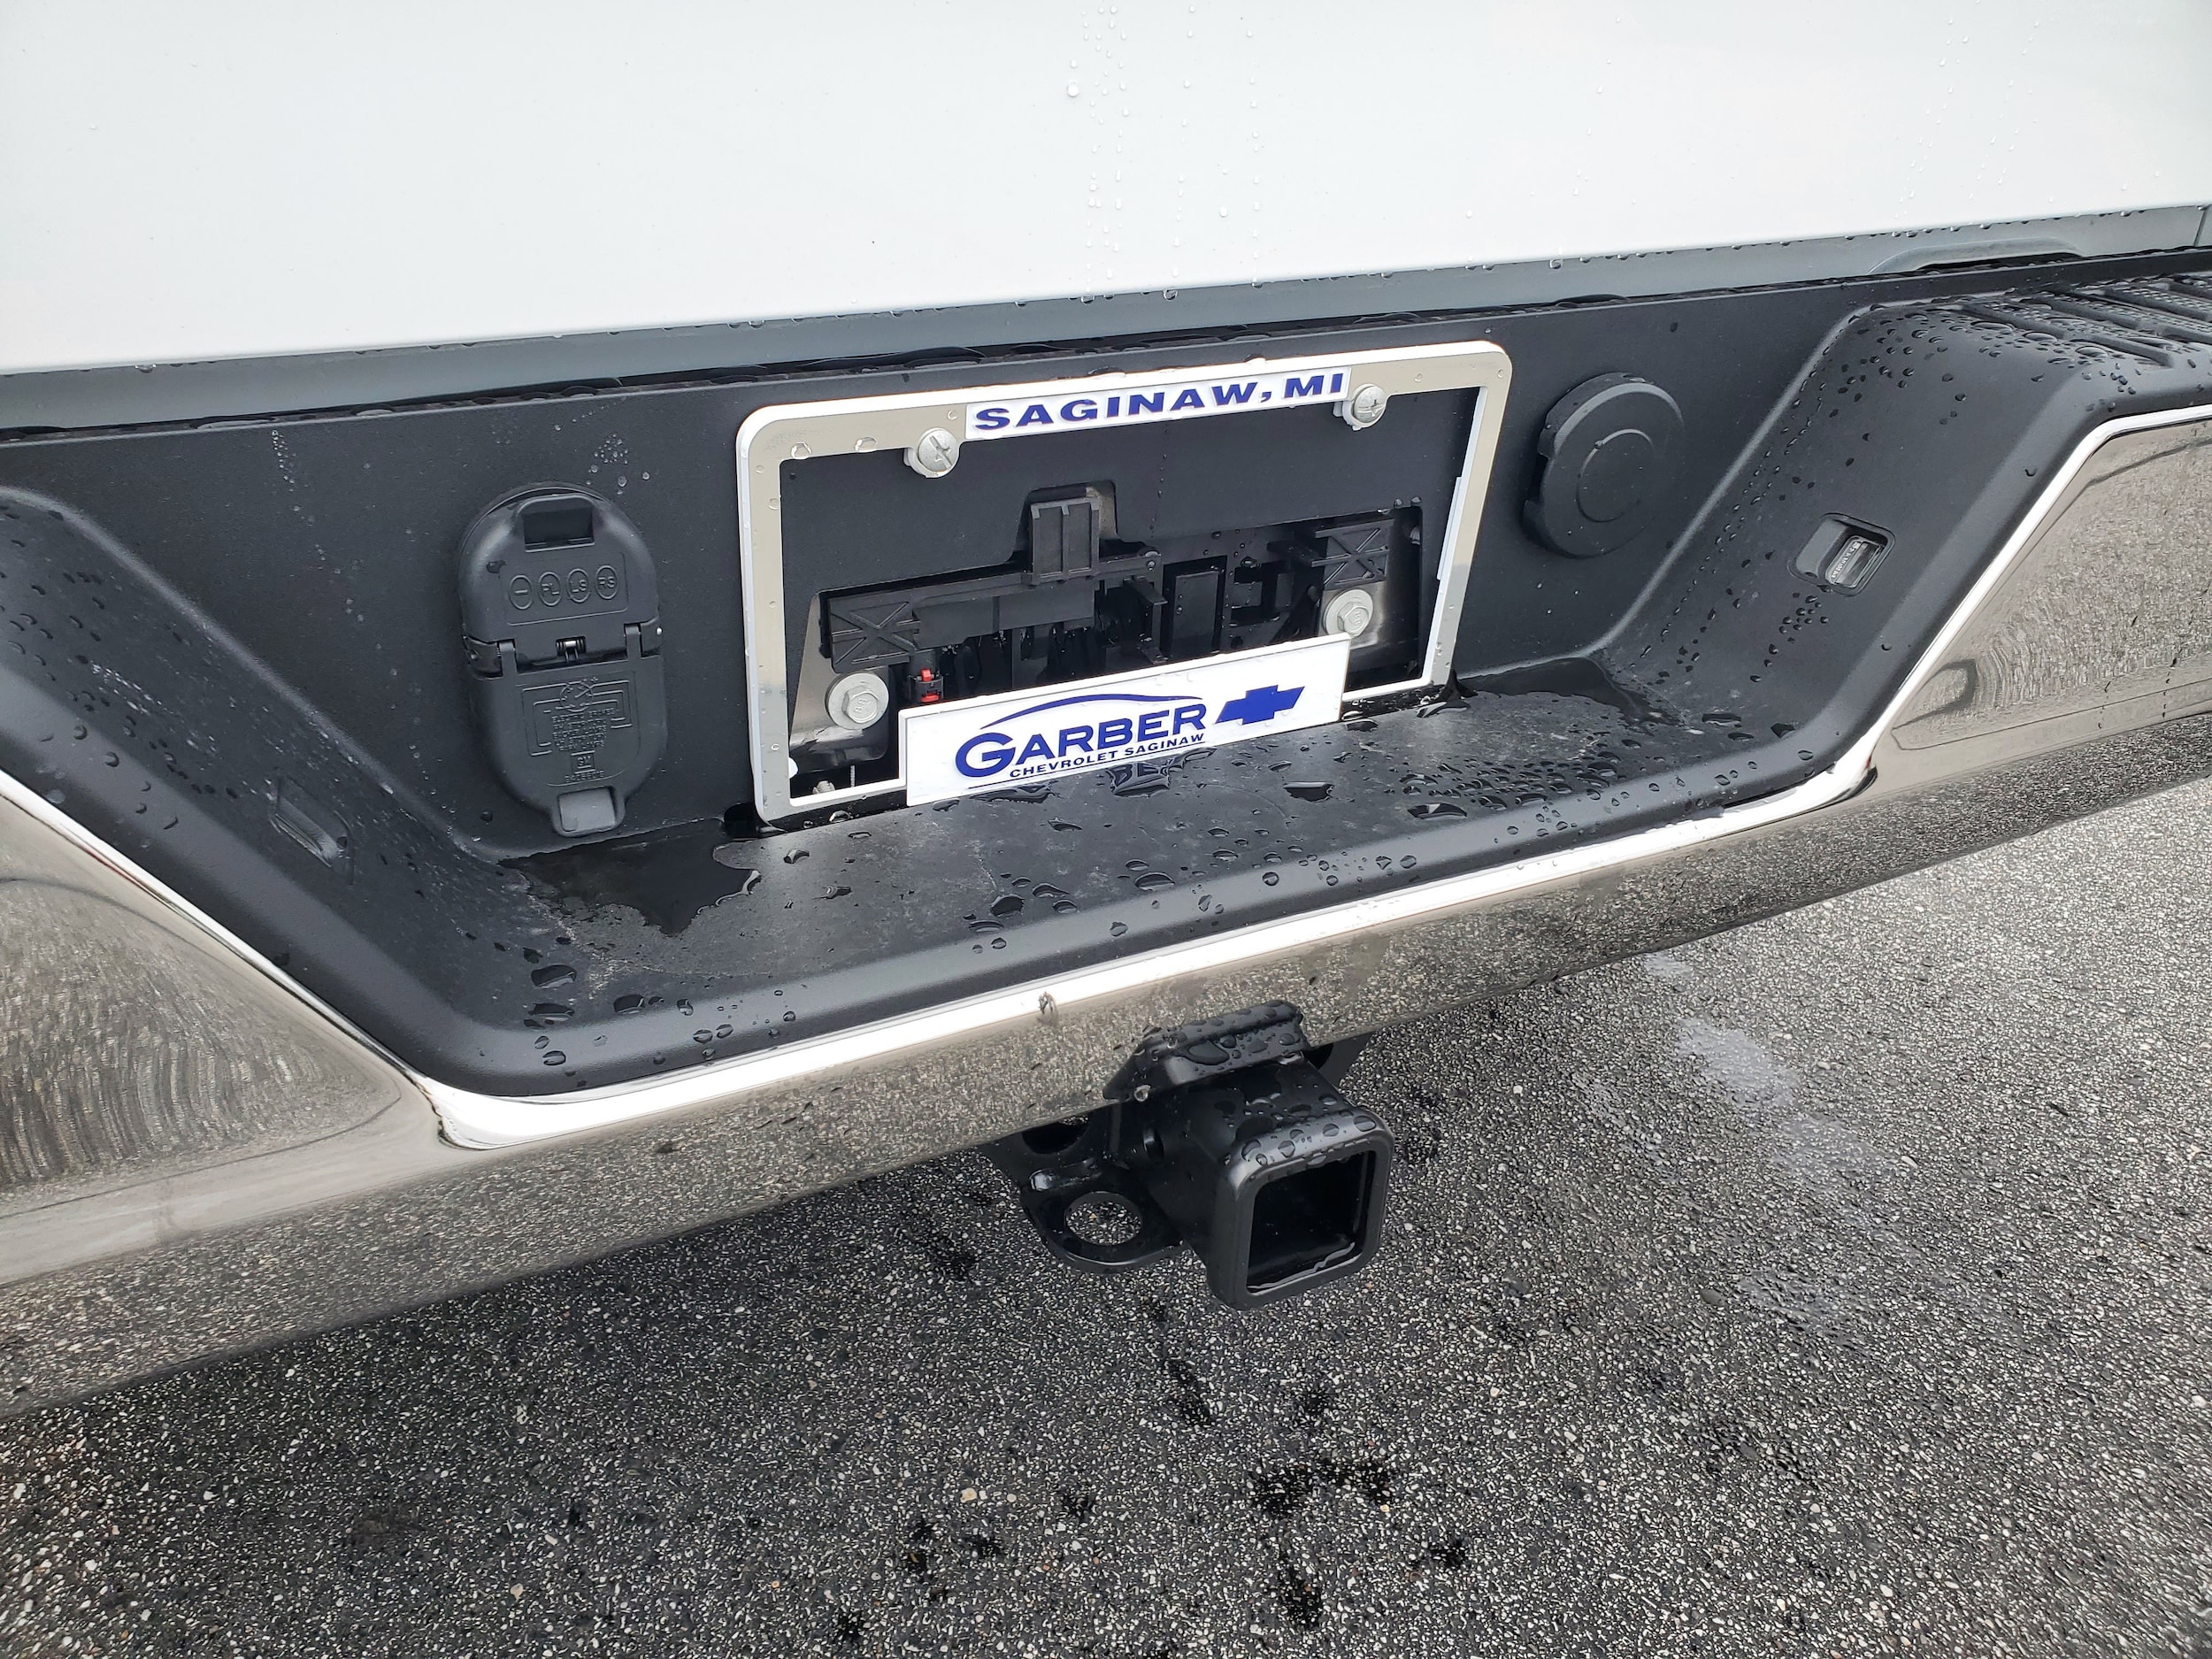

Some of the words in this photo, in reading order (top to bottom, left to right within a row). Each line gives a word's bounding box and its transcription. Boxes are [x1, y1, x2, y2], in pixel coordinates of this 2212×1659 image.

[569, 579, 588, 595] LS
[597, 575, 616, 591] RS
[955, 703, 1207, 778] GARBER
[1010, 750, 1118, 779] CHEVROLET
[1124, 732, 1206, 757] SAGINAW
